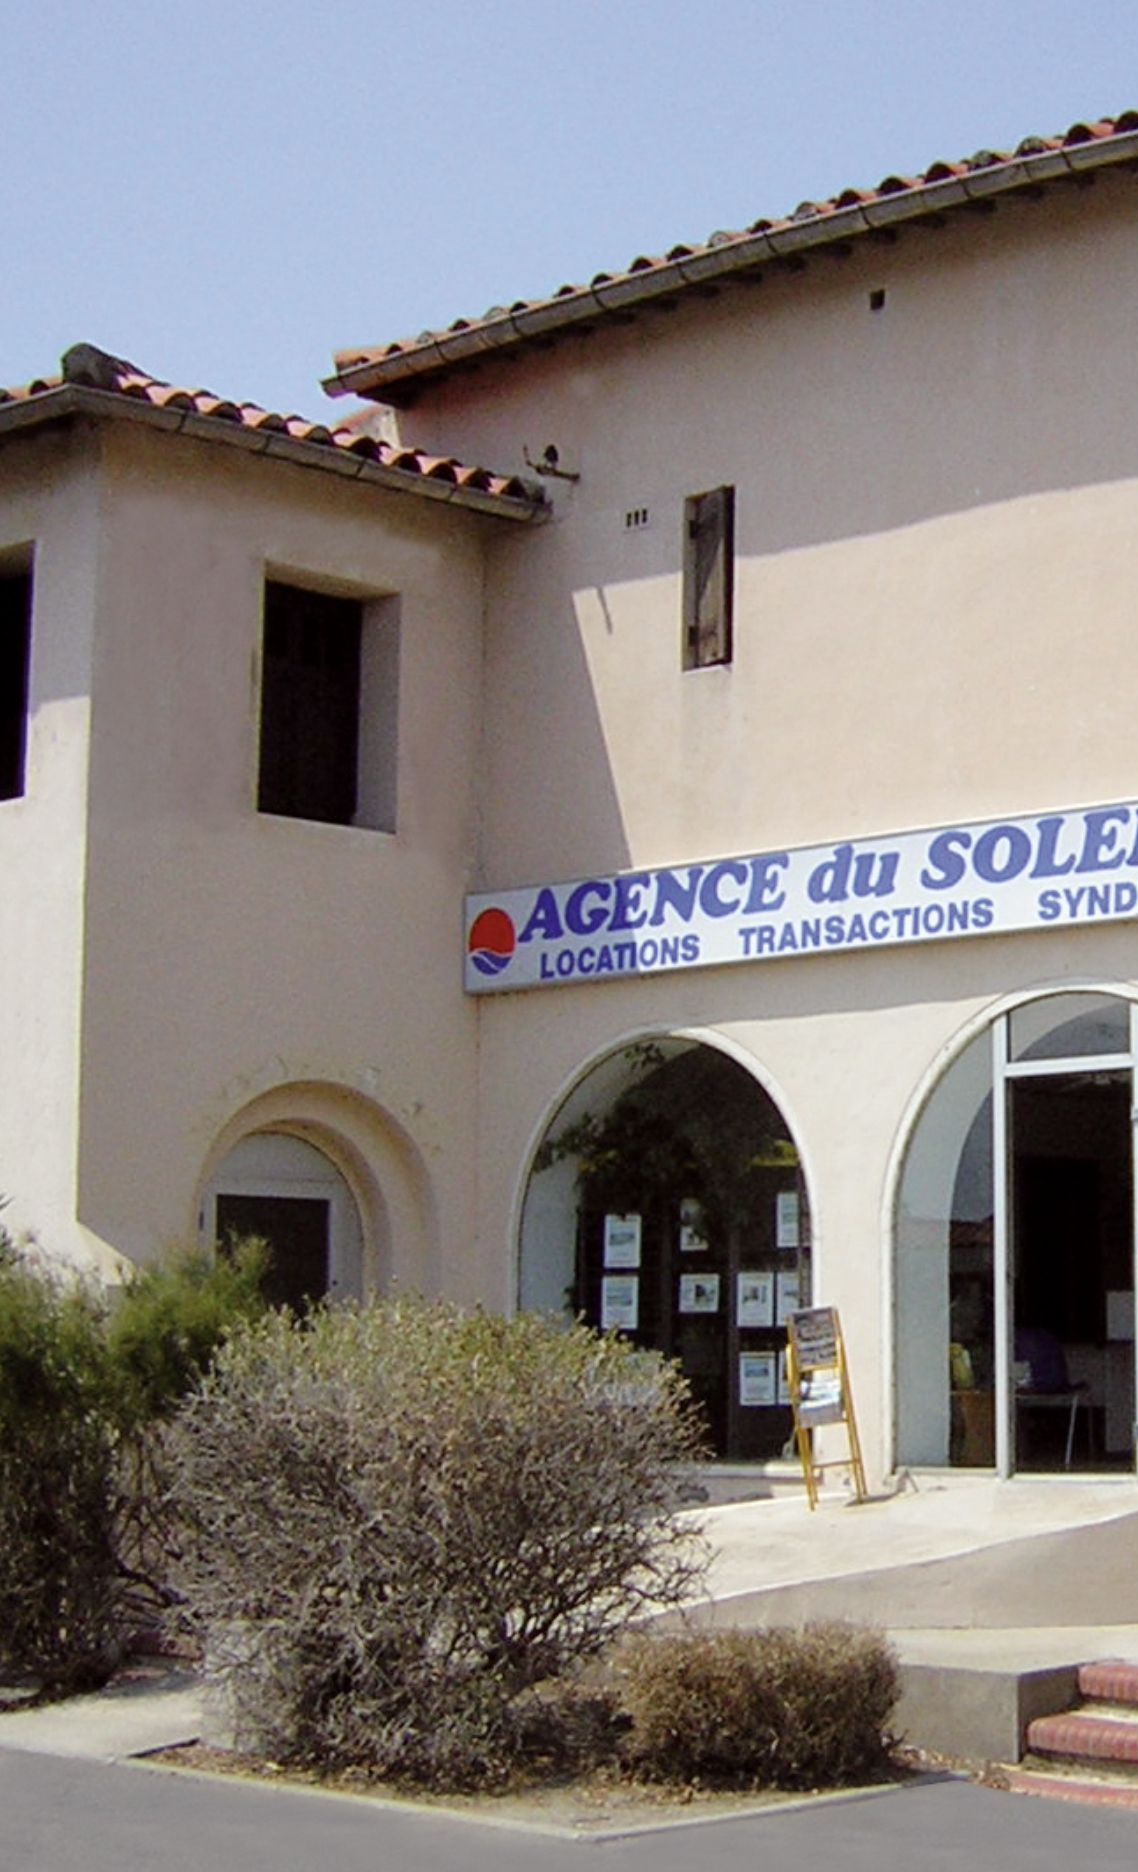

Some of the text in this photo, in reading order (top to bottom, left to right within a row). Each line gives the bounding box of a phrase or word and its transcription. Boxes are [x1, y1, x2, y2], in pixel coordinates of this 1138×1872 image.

[518, 853, 789, 943] AGENCE
[808, 842, 899, 904] du
[540, 935, 700, 979] LOCATIONS
[739, 898, 994, 955] TRANSACTIONS
